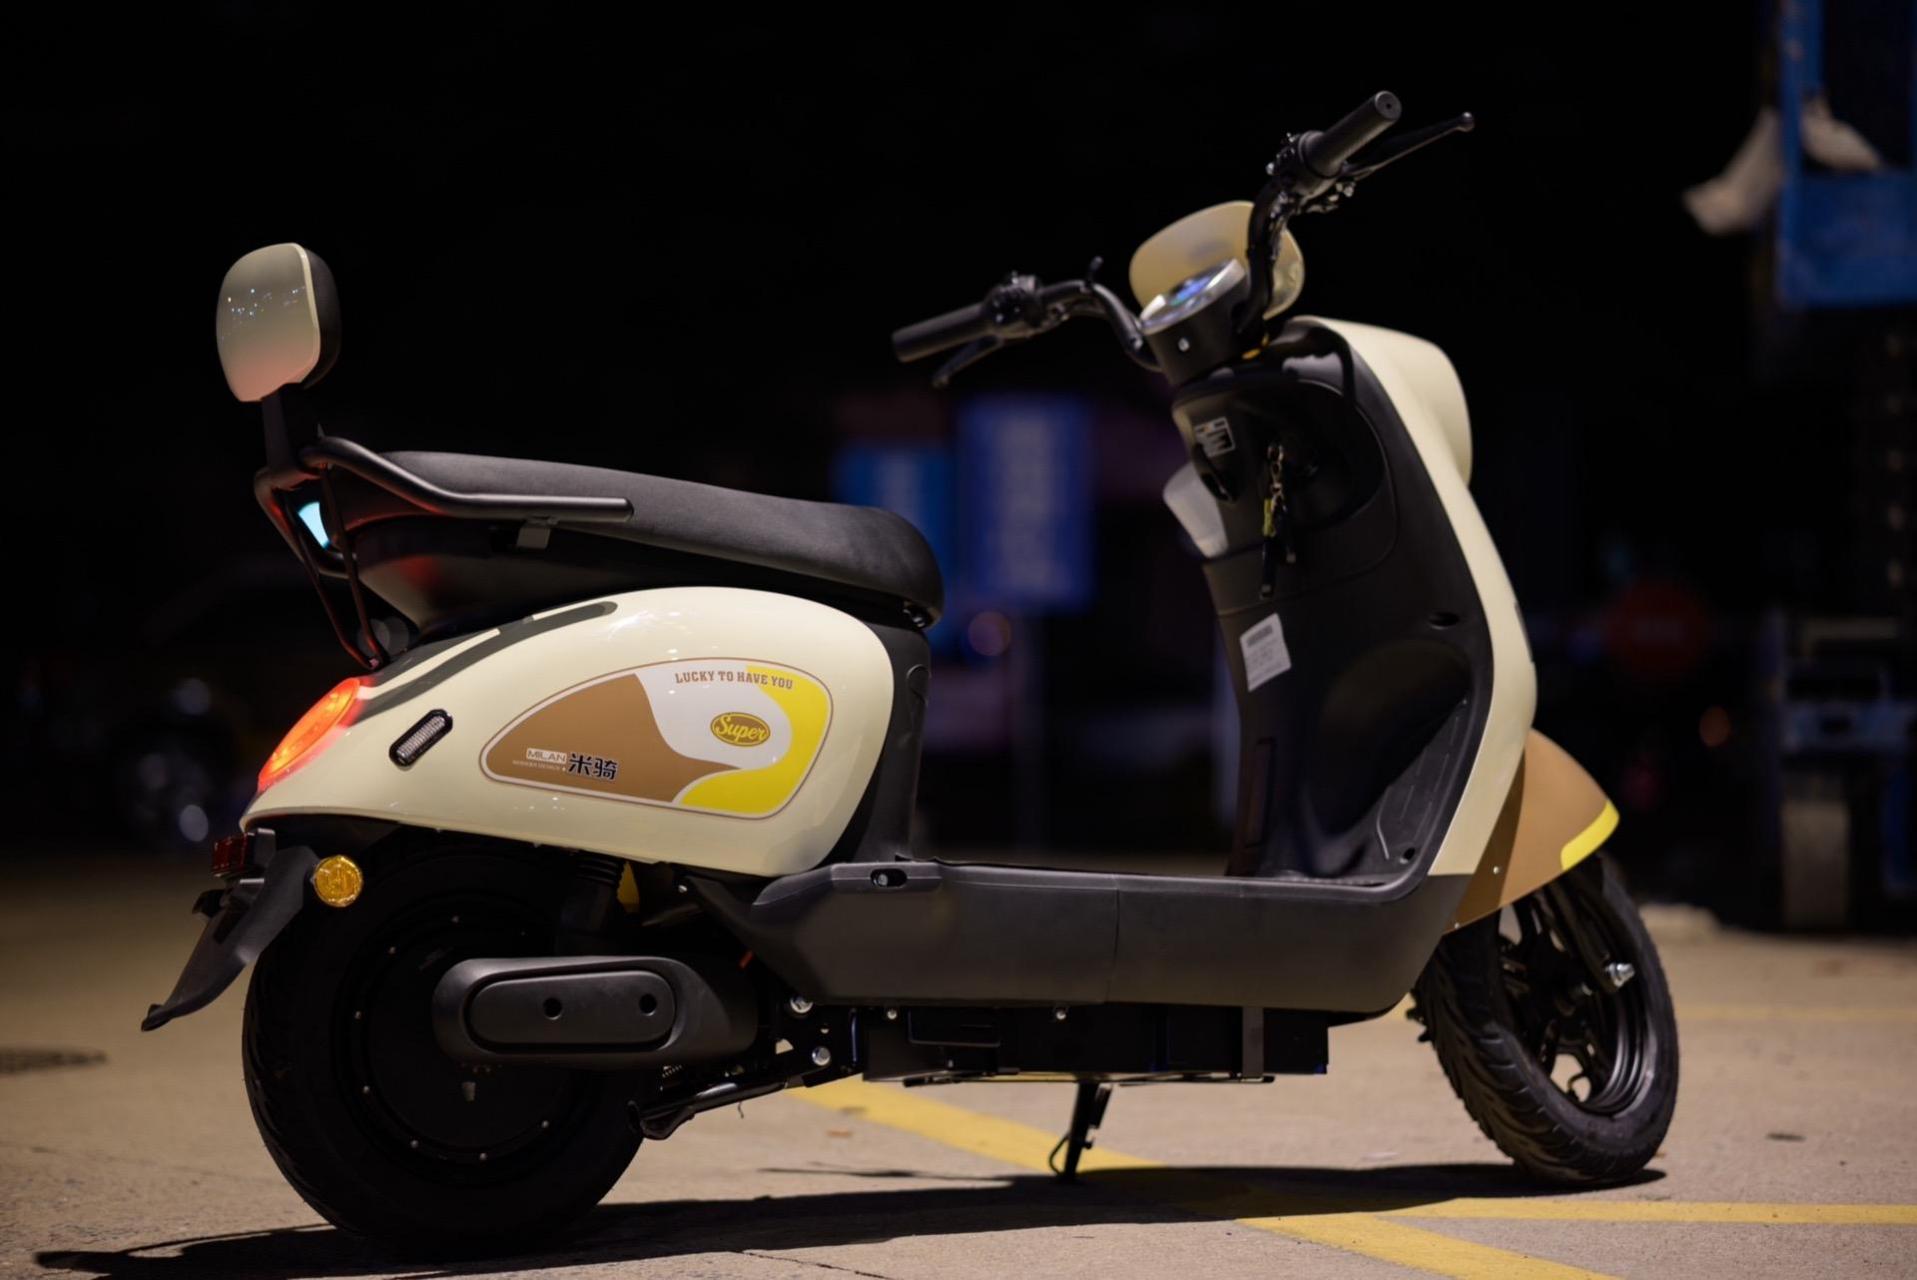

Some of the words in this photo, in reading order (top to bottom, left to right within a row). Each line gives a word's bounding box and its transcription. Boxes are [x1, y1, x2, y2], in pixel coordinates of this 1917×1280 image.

[675, 670, 714, 684] LUCKY
[718, 670, 733, 682] TO
[738, 671, 768, 685] HAVE
[771, 675, 793, 689] YOU
[715, 715, 767, 742] Super
[527, 749, 566, 763] MILAN
[568, 752, 617, 779] 米骑
